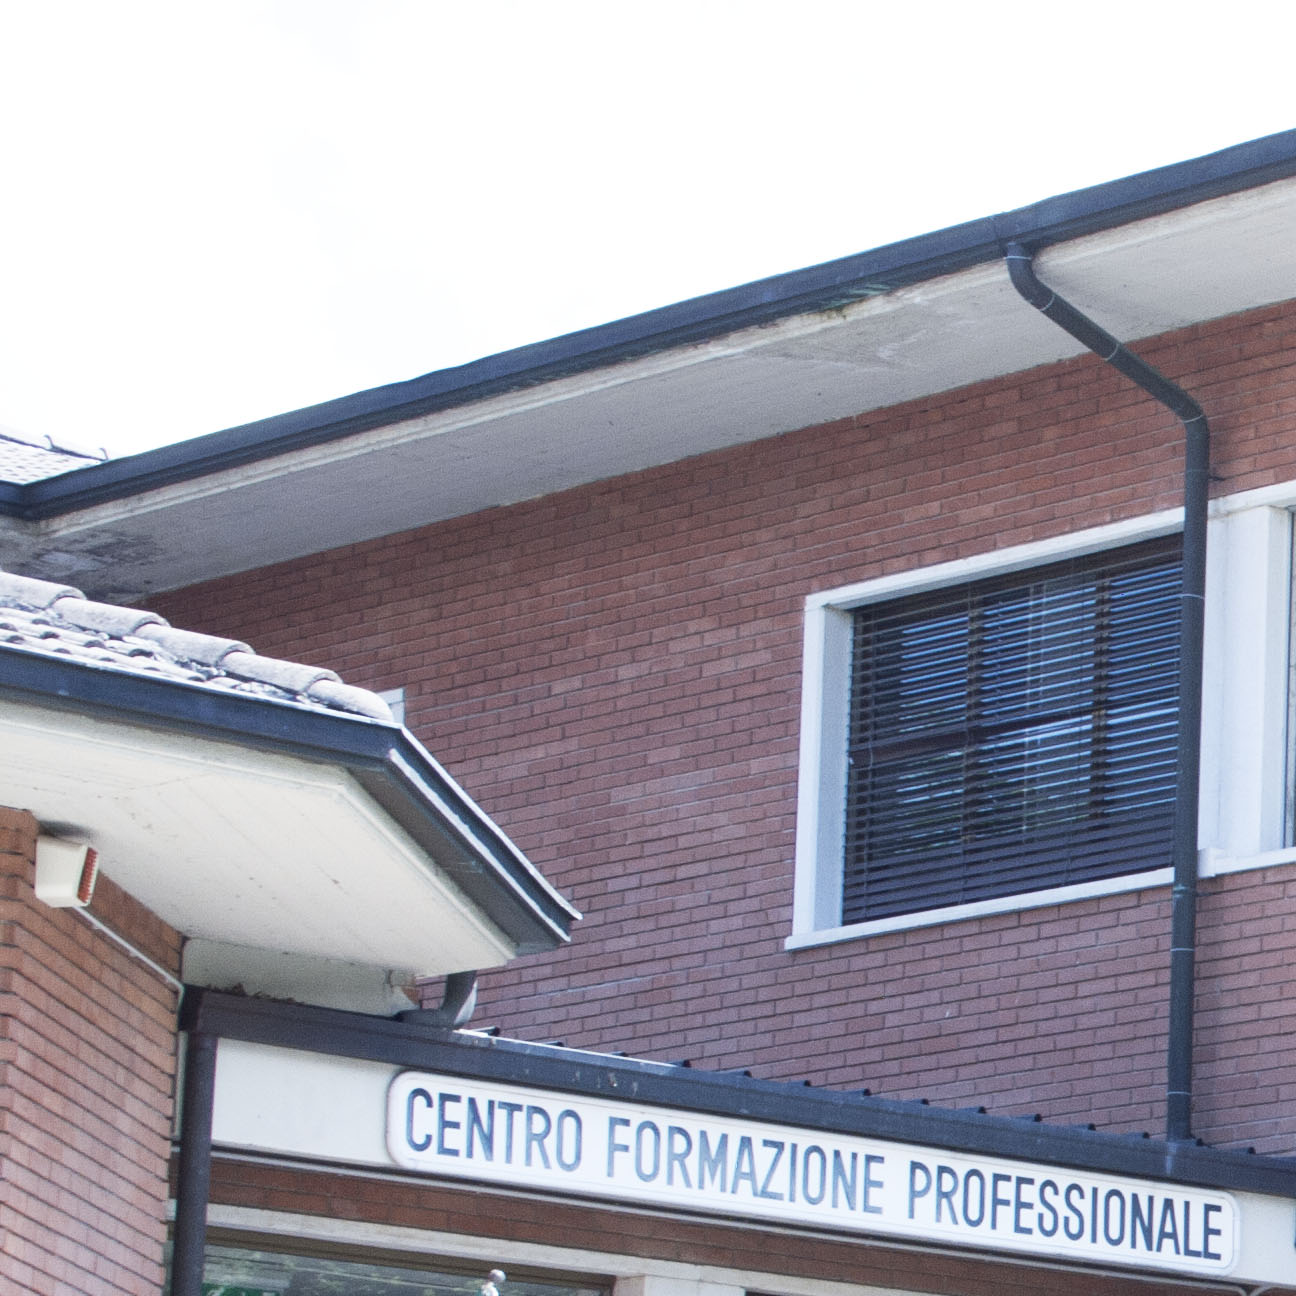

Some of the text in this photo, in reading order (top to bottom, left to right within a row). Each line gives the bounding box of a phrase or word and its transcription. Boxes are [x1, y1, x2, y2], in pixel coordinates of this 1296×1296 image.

[404, 1086, 1224, 1262] CENTRO FORMAZIONE PROFESSIONALE
